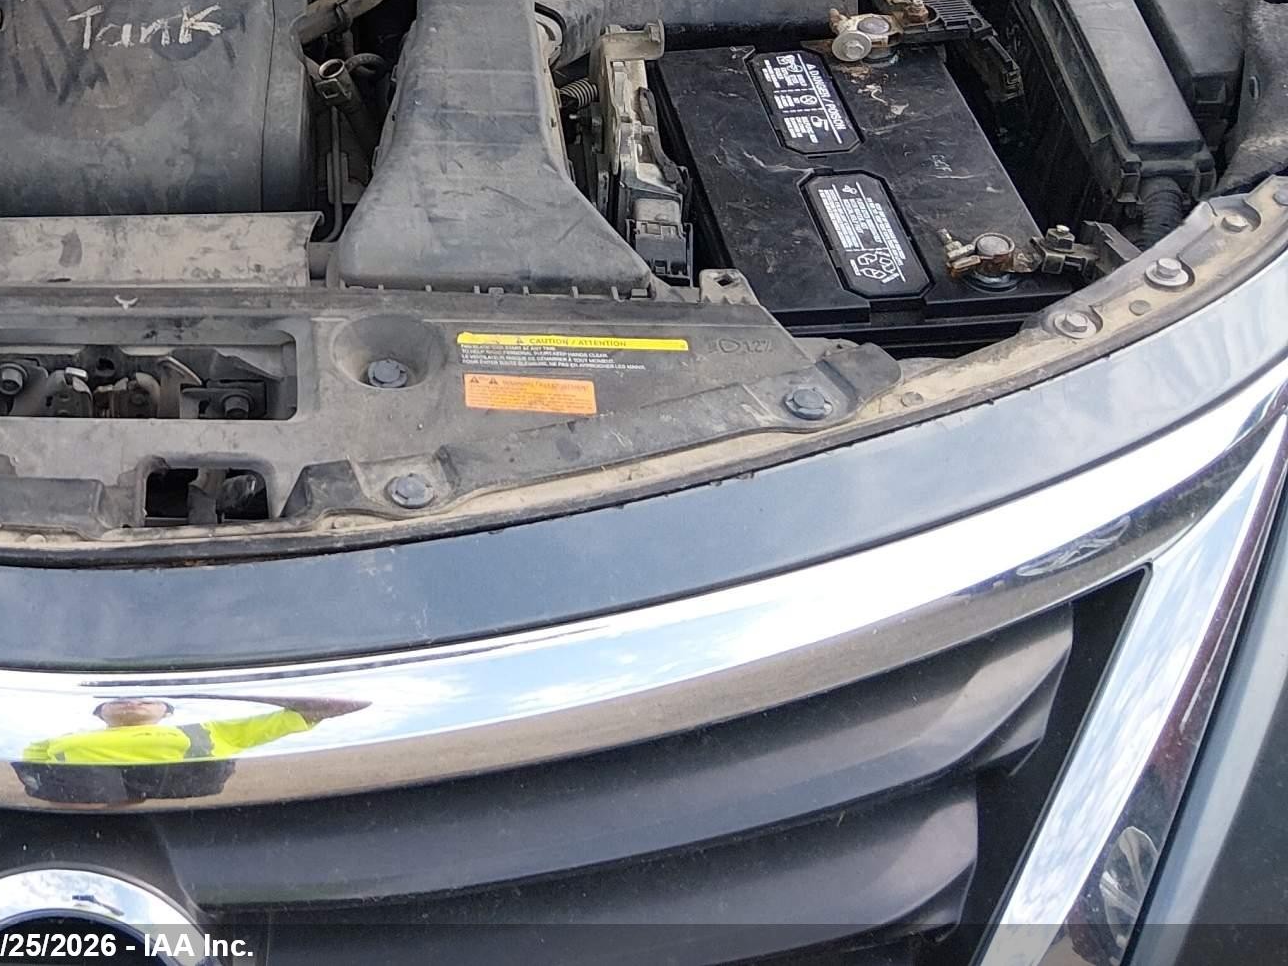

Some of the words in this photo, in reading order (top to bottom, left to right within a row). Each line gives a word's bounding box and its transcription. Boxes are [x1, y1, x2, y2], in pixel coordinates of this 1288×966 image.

[809, 70, 831, 98] DANGER
[825, 103, 847, 130] POISON
[529, 338, 568, 346] CAUTION
[578, 339, 627, 347] ATTENTION
